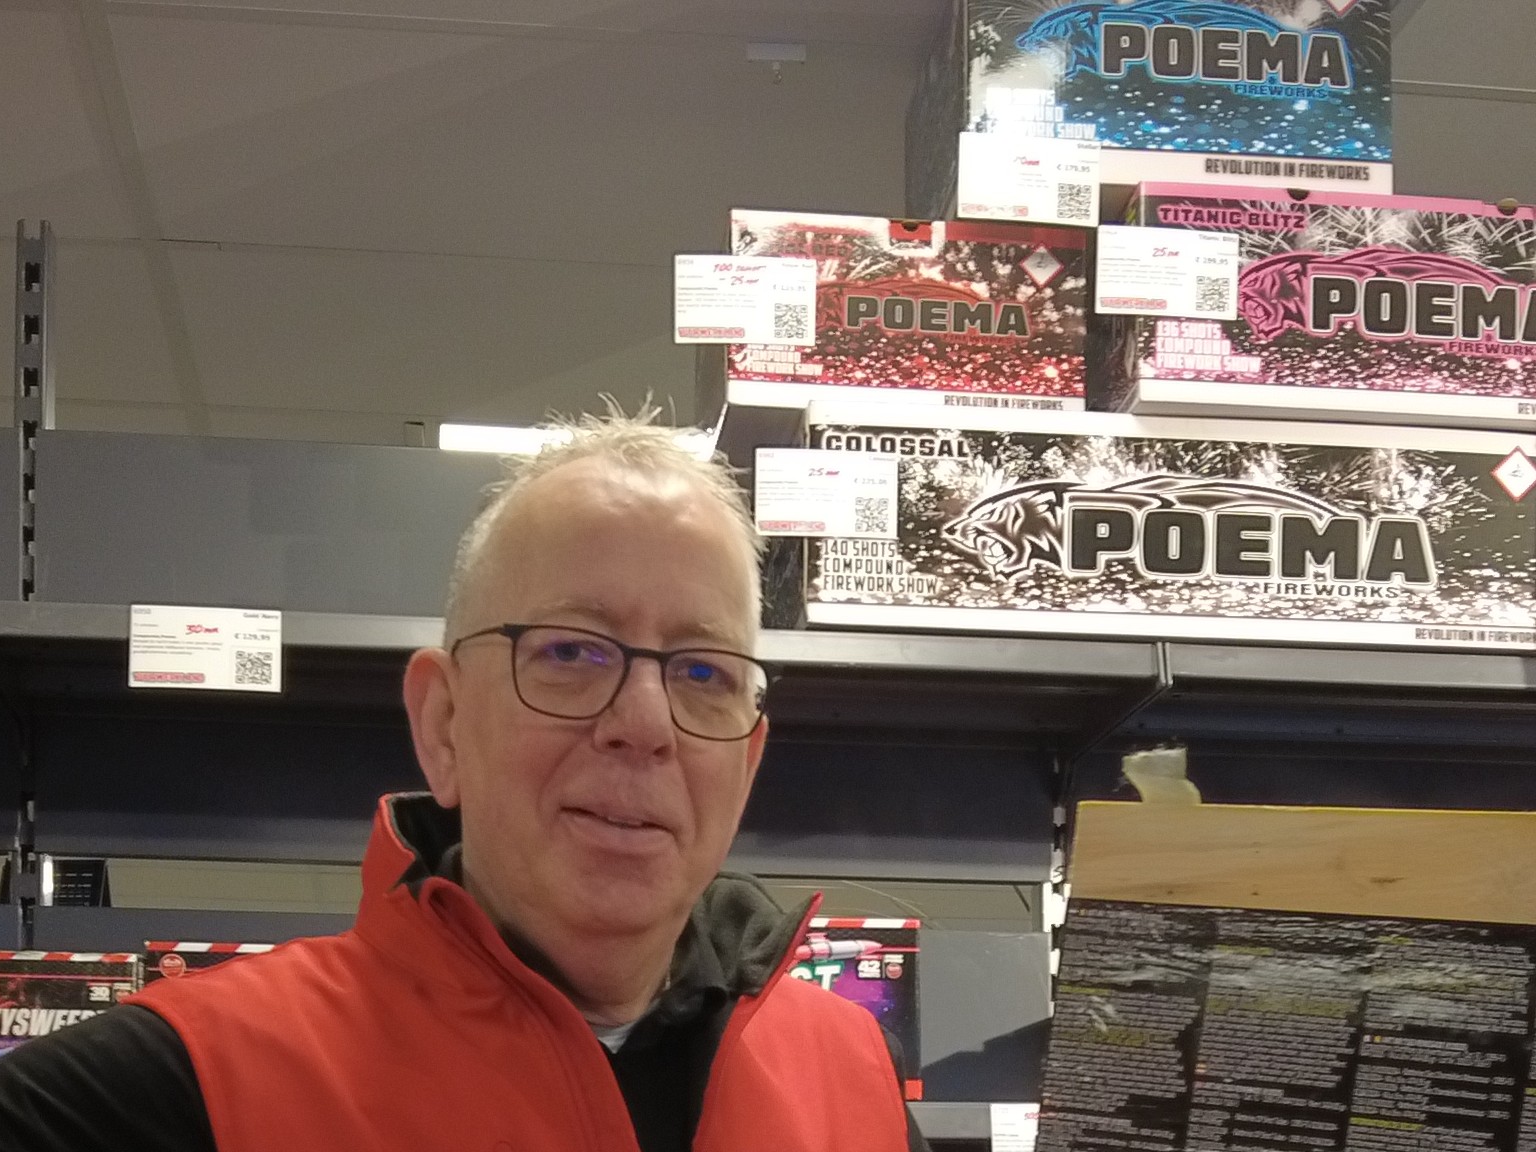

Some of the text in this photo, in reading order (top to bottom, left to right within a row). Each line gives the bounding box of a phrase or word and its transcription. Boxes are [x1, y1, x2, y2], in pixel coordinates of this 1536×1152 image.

[1100, 21, 1352, 87] POEMA
[1234, 84, 1328, 99] FIREWORKS
[1205, 158, 1370, 181] REVOLUTION IN FIREWORKS
[1160, 206, 1306, 229] TITANIC BLITZ
[846, 295, 1031, 337] POEMA
[944, 394, 1064, 411] REVOLUTION IN FIREWORKS
[825, 434, 970, 458] COLOSSAL
[824, 540, 896, 557] 140 SHOTS
[1068, 505, 1437, 585] POEMA
[824, 558, 904, 575] COMPOUND
[823, 575, 938, 593] FIREWORK SHOW
[1264, 581, 1401, 601] FIREWORKS
[1414, 626, 1474, 643] REVOLUTION
[1477, 628, 1487, 642] IN
